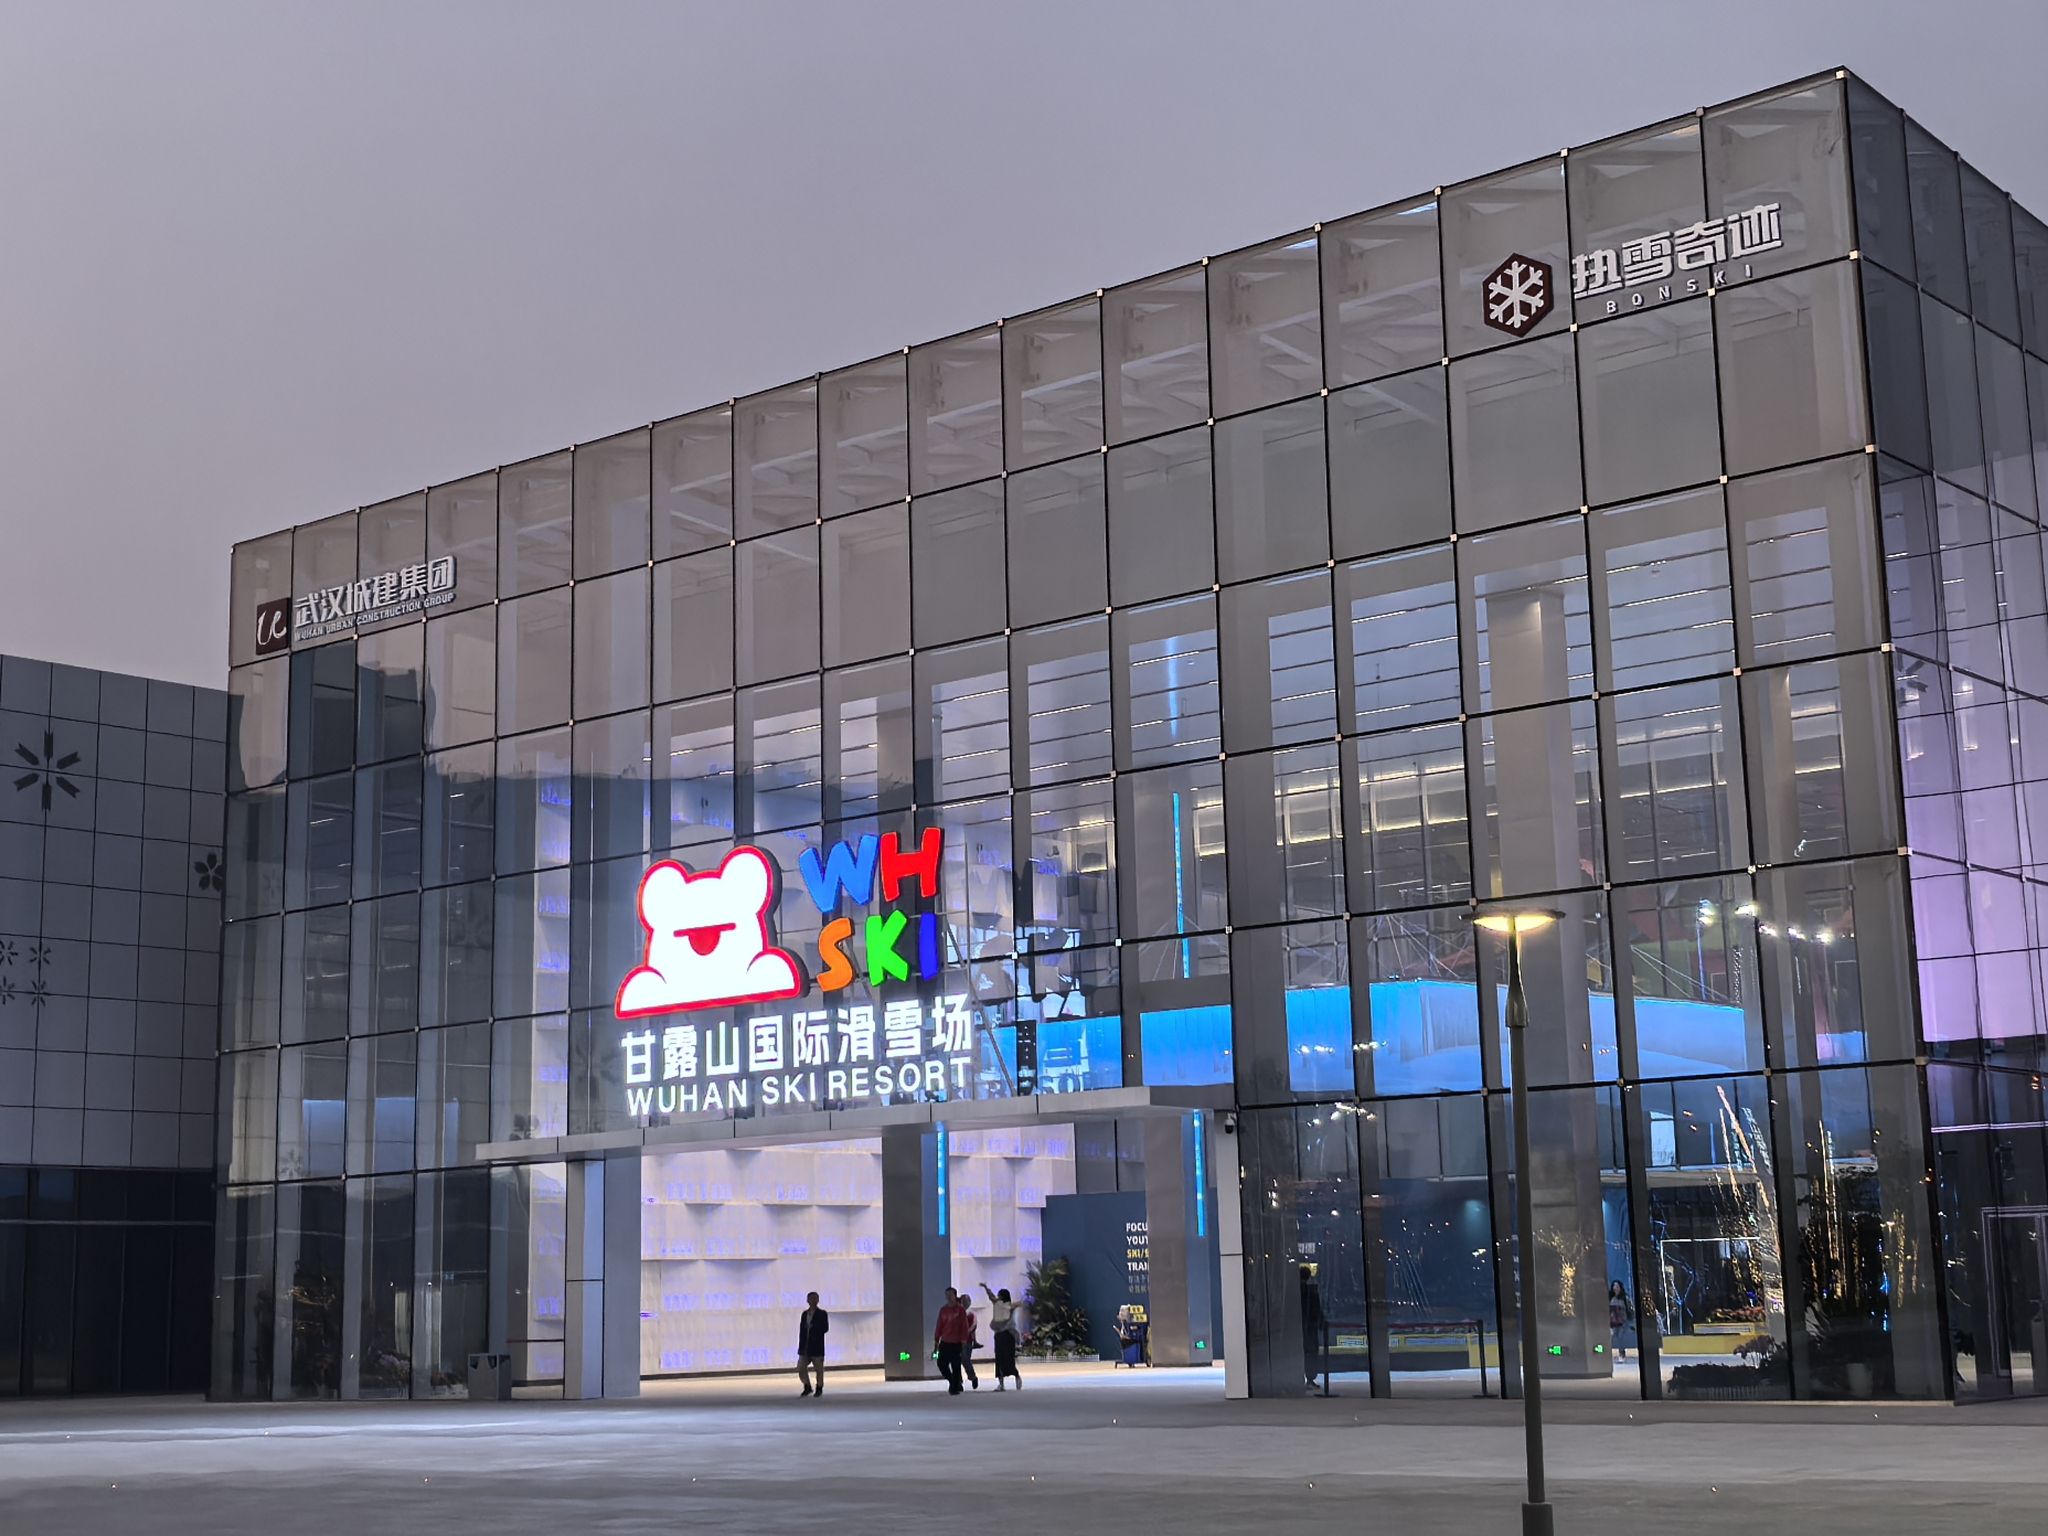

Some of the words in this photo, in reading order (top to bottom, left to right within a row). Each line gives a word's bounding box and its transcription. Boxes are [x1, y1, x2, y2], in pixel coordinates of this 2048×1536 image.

[1571, 203, 1783, 299] 热雪奇迹
[294, 554, 456, 628] 武汉城建集团
[295, 624, 324, 641] WUHAN
[326, 616, 354, 636] URBAN
[356, 600, 421, 626] CONSTRUCTION
[423, 592, 456, 609] GROUP
[800, 826, 943, 912] WH
[816, 909, 939, 992] SKI
[620, 993, 973, 1085] 甘露山国际滑雪场
[627, 1078, 748, 1118] WUHAN
[762, 1070, 817, 1106] SKI
[827, 1056, 972, 1102] RESORT
